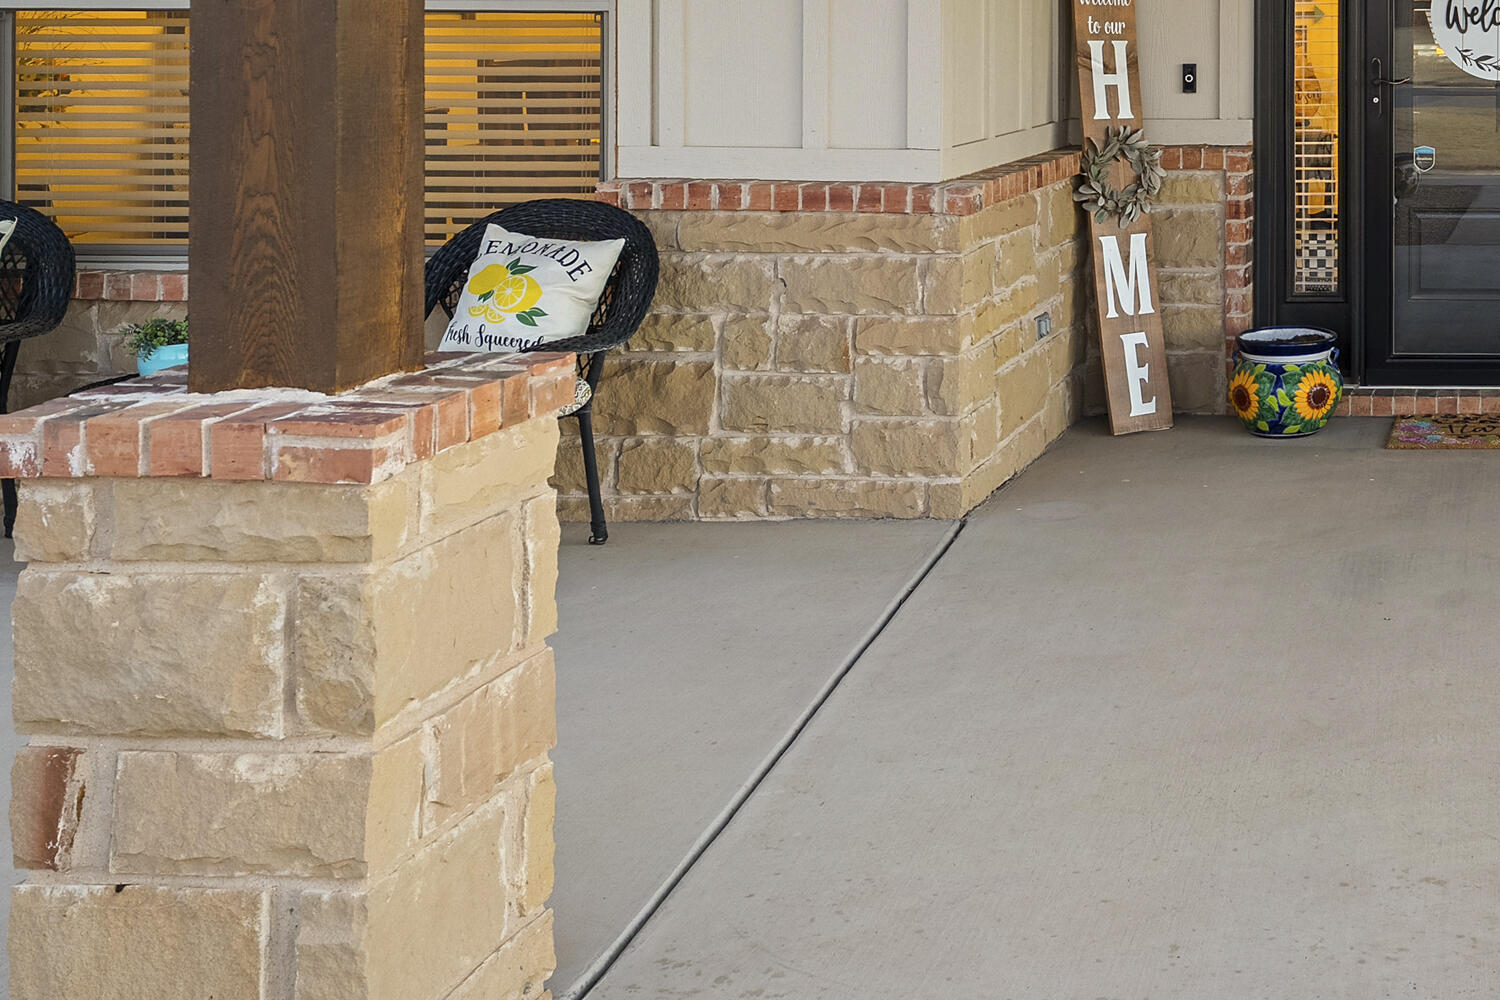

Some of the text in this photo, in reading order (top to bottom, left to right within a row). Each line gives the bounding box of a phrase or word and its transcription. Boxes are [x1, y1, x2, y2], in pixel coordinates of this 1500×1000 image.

[1087, 15, 1126, 35] to our
[474, 240, 593, 283] EMONADE
[445, 321, 472, 345] Fresh
